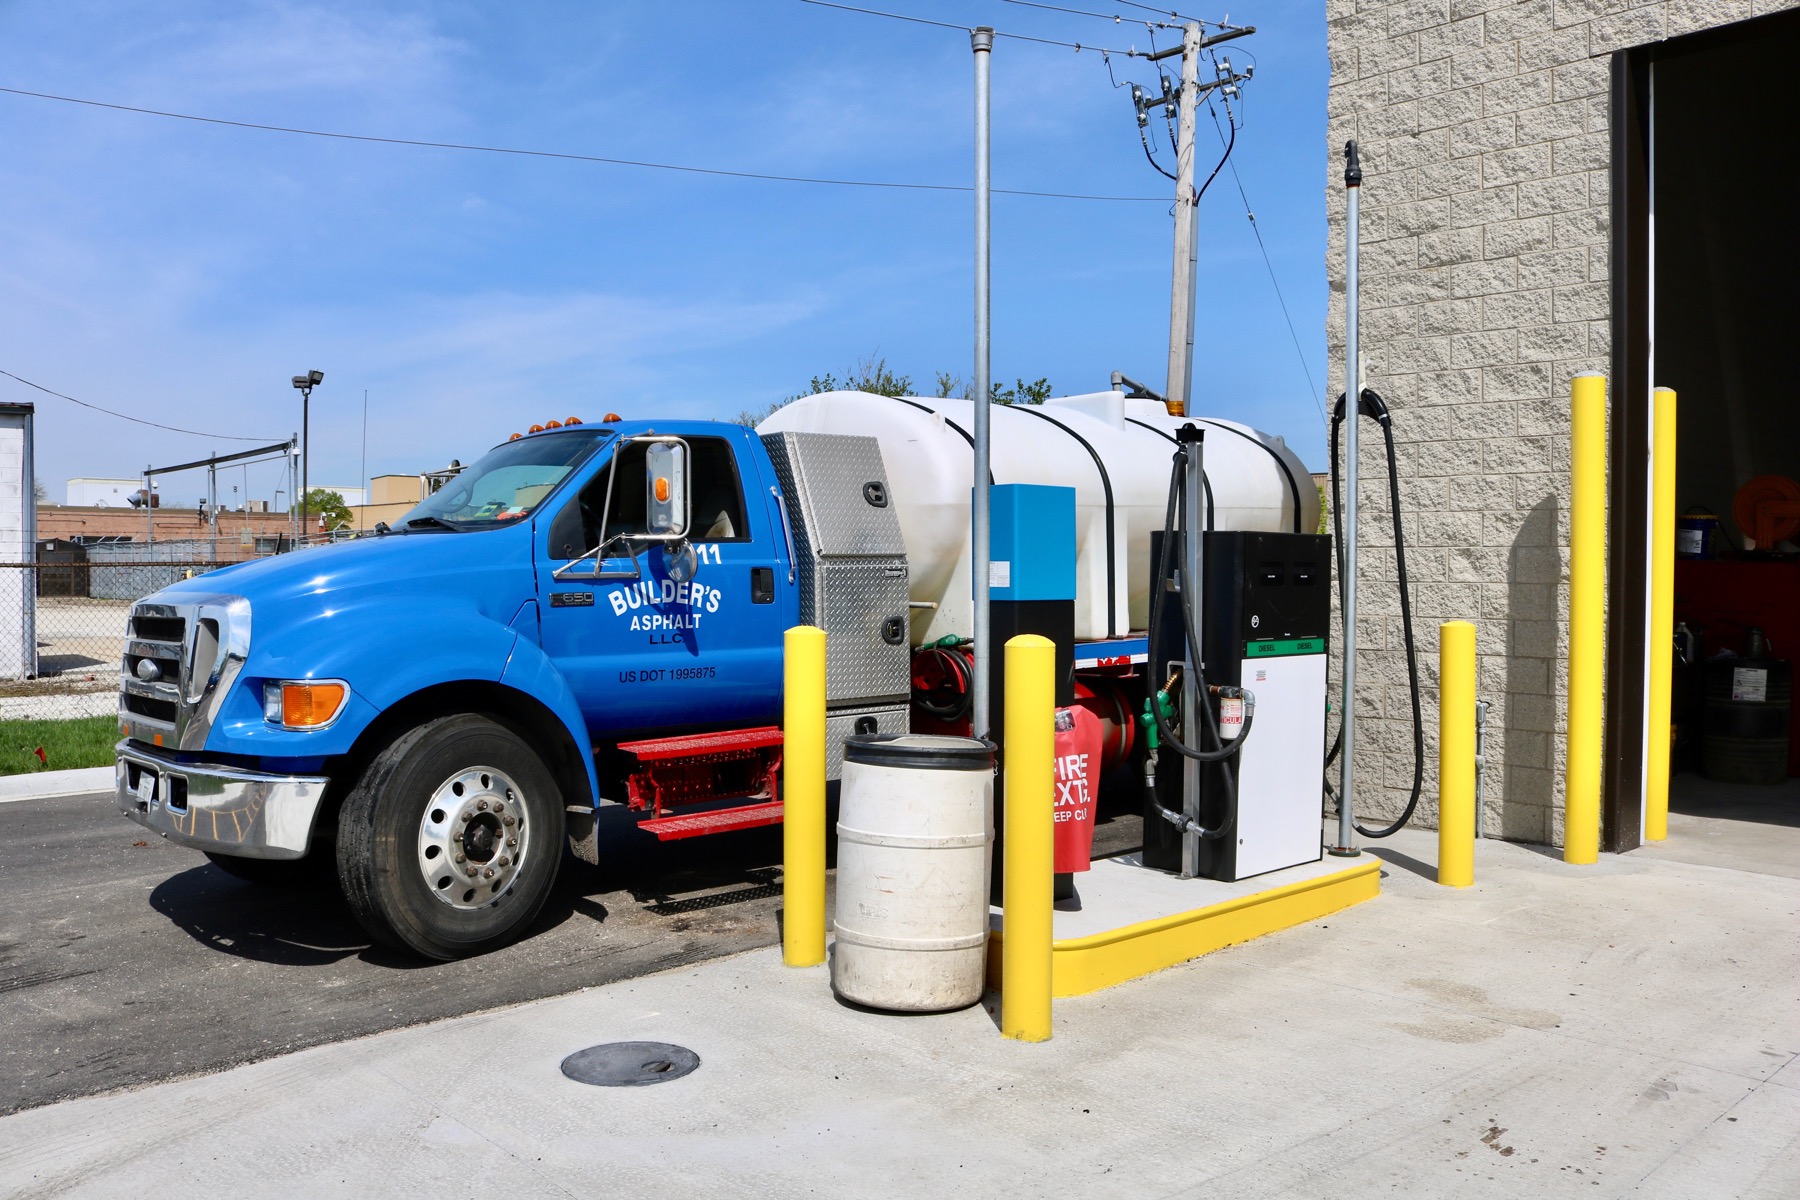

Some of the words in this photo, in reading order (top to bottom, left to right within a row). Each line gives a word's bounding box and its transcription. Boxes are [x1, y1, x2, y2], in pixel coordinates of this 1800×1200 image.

[696, 544, 722, 565] 11
[608, 579, 722, 617] BUILDER'S
[630, 613, 702, 631] ASPHALT
[1258, 644, 1275, 653] DIESEL
[1297, 642, 1313, 650] DIESEL
[619, 671, 636, 683] US
[640, 669, 666, 682] DOT
[669, 667, 716, 680] 1995875
[1054, 753, 1089, 781] IRE
[1054, 778, 1091, 807] XTG.
